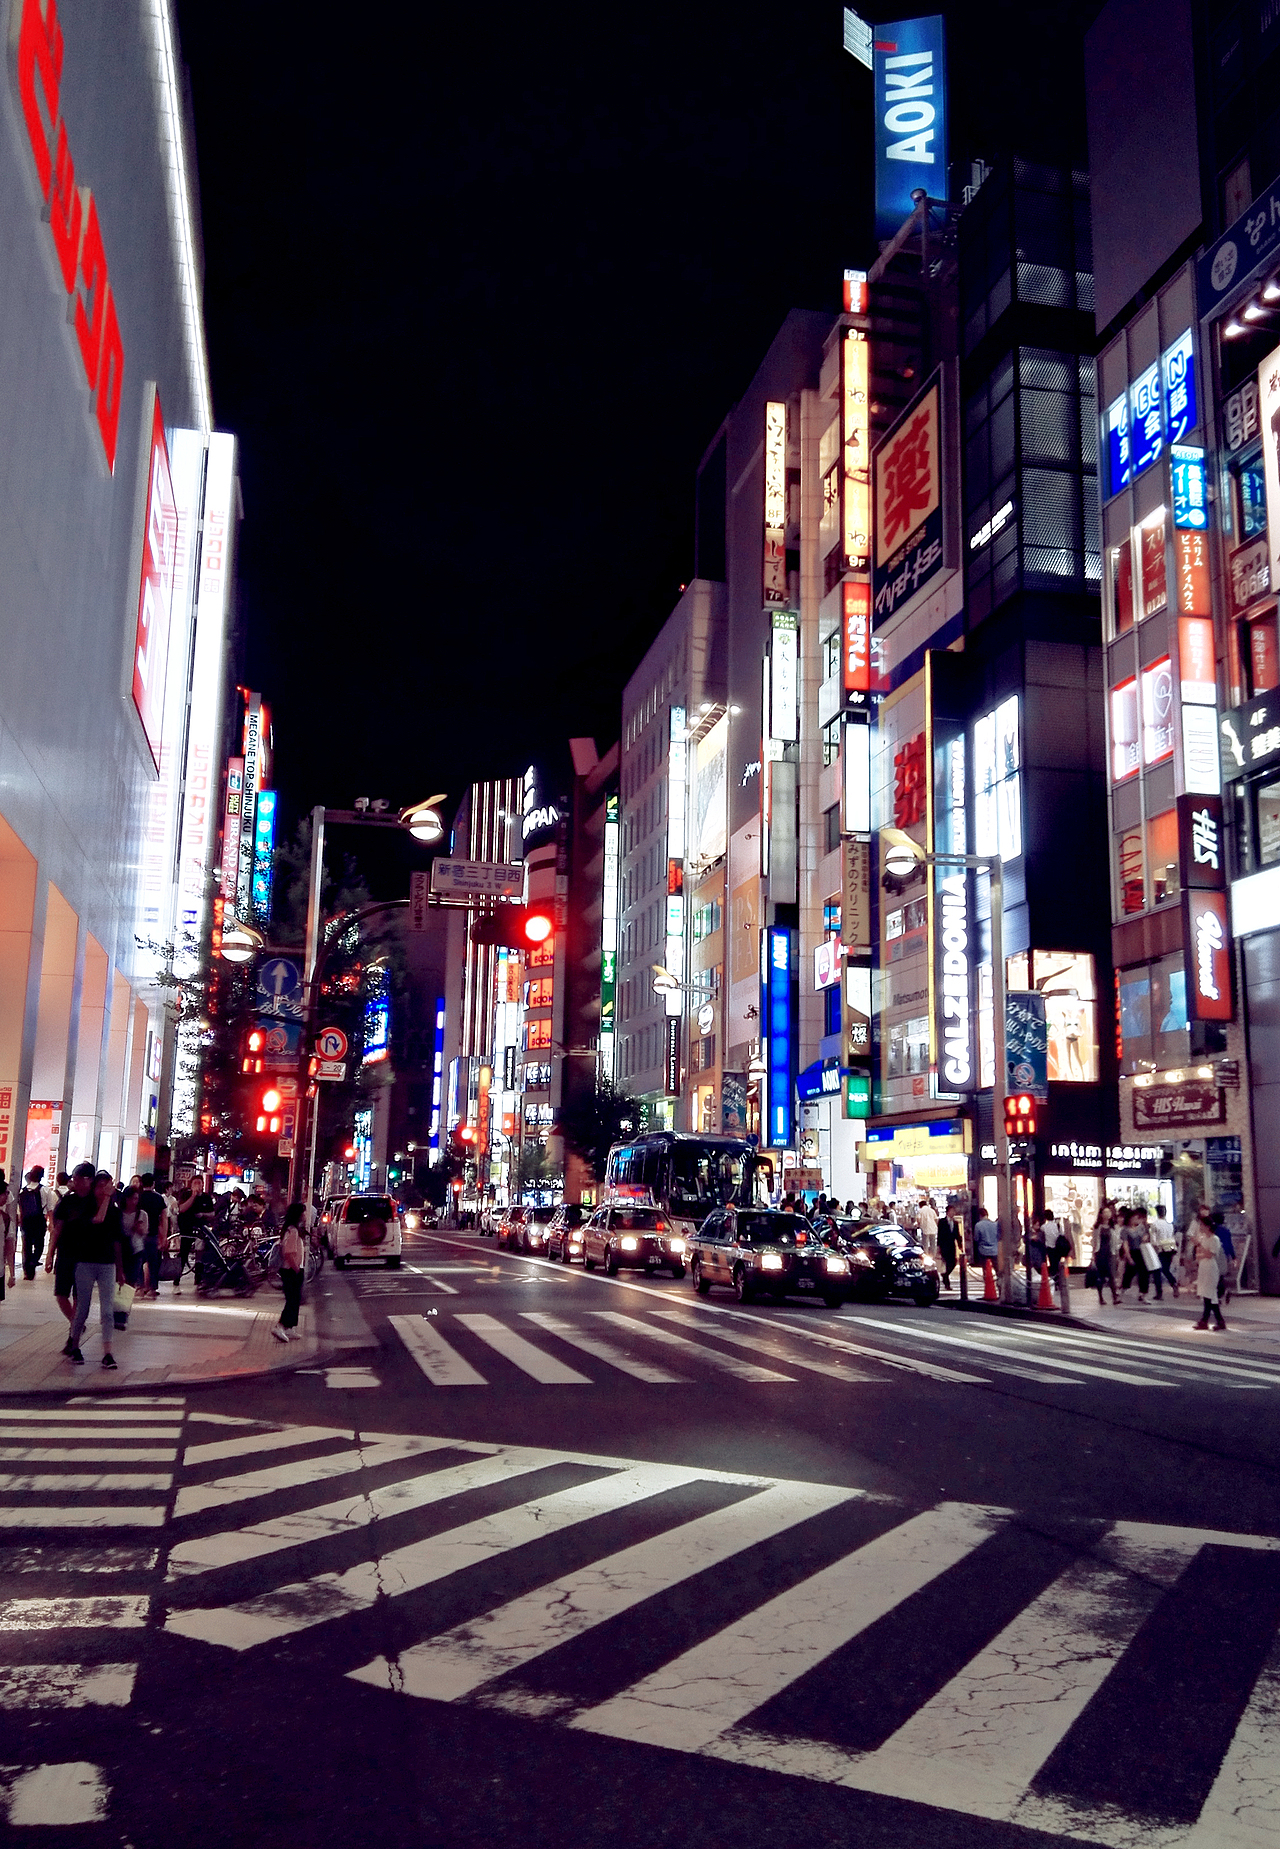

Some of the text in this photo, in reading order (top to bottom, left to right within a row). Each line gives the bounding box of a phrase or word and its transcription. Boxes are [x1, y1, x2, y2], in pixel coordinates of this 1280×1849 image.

[884, 50, 934, 164] AOKI
[848, 330, 865, 341] 9F
[884, 409, 932, 549] 薬
[1173, 463, 1190, 525] イーオン
[767, 509, 782, 519] 8F
[848, 555, 866, 568] 9F
[1192, 535, 1204, 566] スリム
[1181, 534, 1194, 611] ビューティハウス
[848, 614, 867, 672] ガスト
[241, 714, 259, 833] MEGANE TOP SHINJUKU
[229, 818, 239, 868] BRAND
[438, 863, 522, 882] 新宿三丁目西
[453, 878, 484, 889] Shinjuku
[847, 843, 860, 944] みずのクリニック
[182, 910, 198, 924] GU
[773, 935, 788, 971] AOKI
[941, 873, 971, 1085] CALZEDONIA
[822, 1069, 841, 1092] AOKI
[772, 1138, 787, 1146] AOKI
[937, 1163, 950, 1177] Free
[1073, 1158, 1142, 1171] Italian Lingerie
